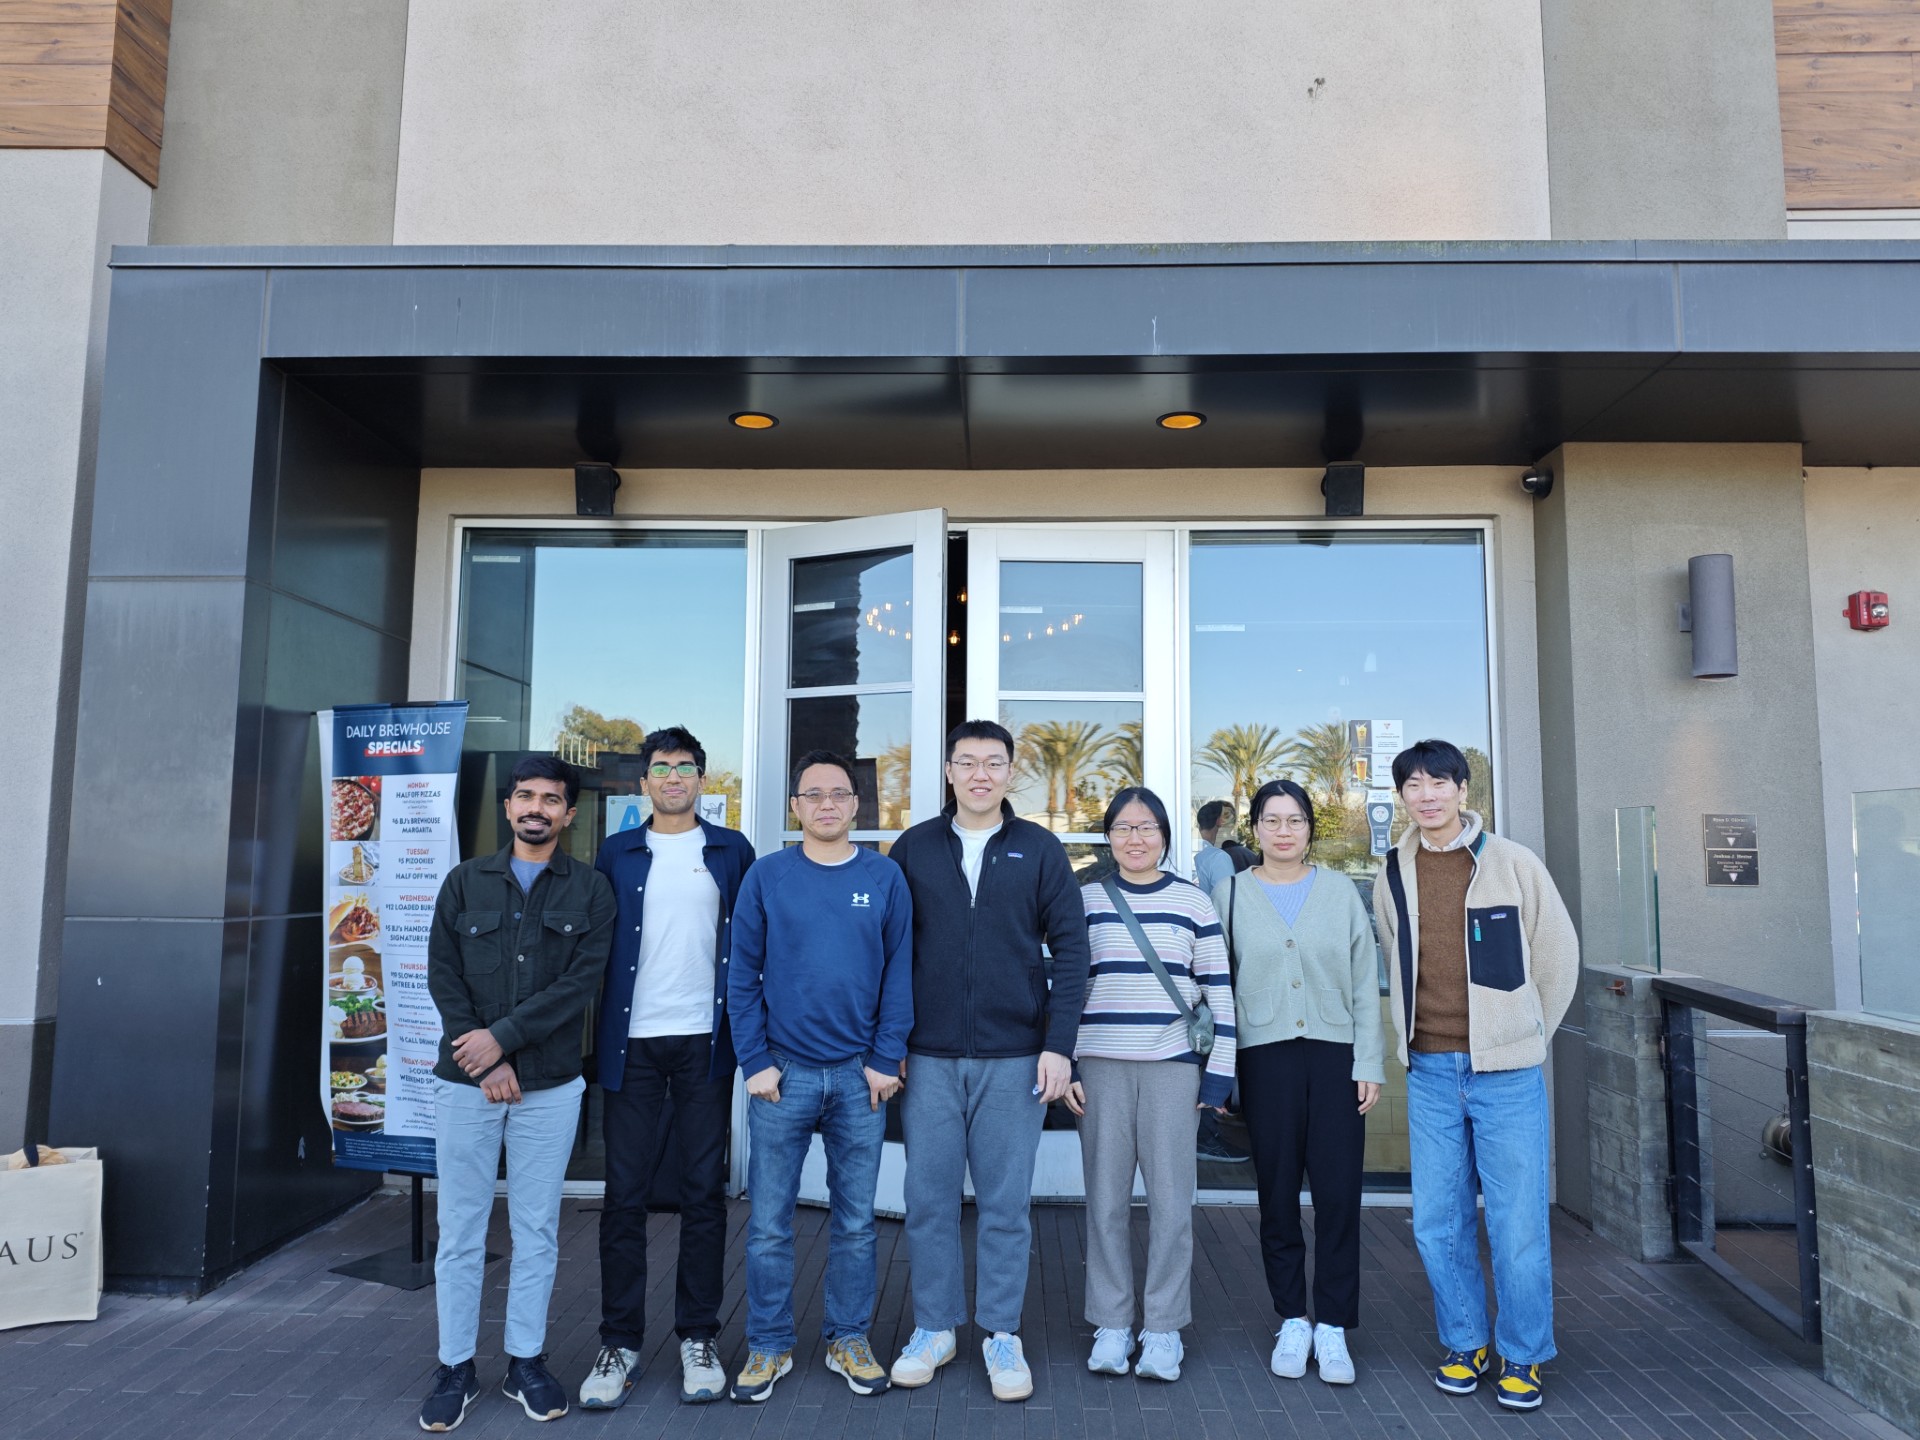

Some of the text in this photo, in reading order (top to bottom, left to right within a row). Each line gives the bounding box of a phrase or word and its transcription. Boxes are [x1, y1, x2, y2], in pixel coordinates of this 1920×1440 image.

[346, 722, 451, 738] DAILY BREWHOUSE
[619, 805, 641, 832] A
[390, 934, 424, 942] SIGNATURE
[398, 972, 428, 980] SLOW-ROA
[401, 1056, 436, 1067] FRIDAY-SUND
